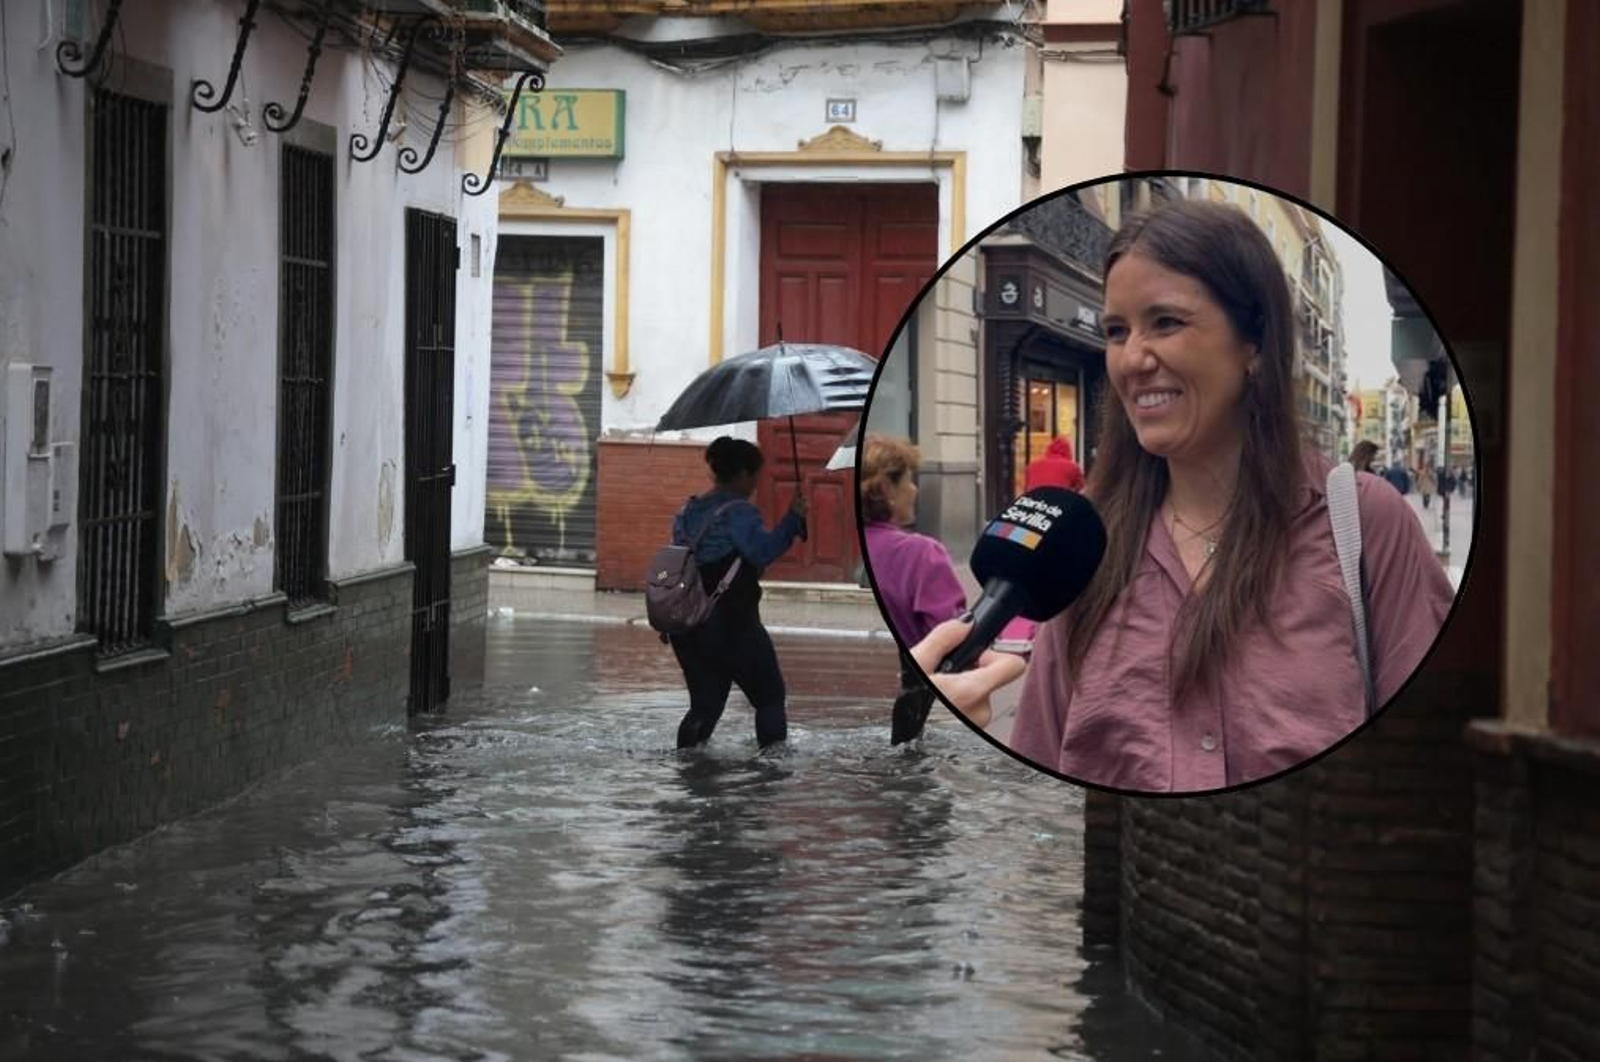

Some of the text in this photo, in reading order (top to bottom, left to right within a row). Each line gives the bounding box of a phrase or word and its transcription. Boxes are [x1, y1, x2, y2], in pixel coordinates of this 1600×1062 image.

[506, 95, 580, 130] RA
[832, 103, 848, 115] 64
[1014, 496, 1063, 517] Diario de
[1002, 506, 1052, 531] Sevilla
